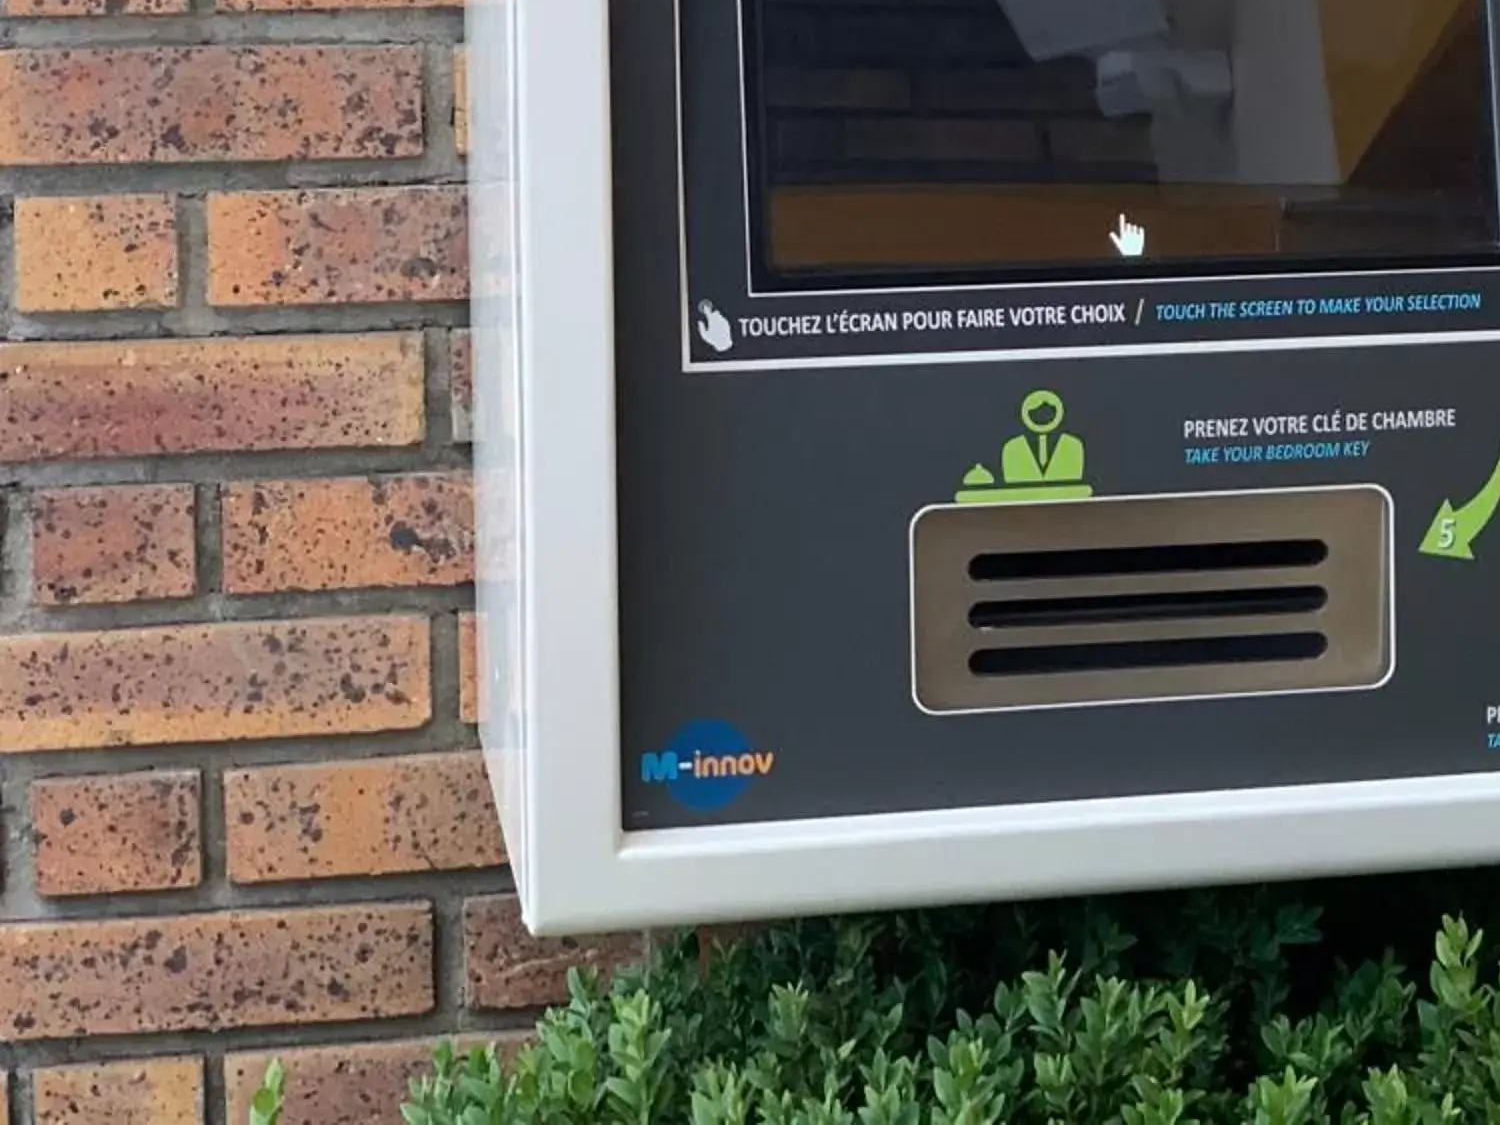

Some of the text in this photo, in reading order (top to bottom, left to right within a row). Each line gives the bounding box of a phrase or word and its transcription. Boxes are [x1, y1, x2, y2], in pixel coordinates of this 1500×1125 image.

[738, 315, 821, 337] TOUCHEZ
[902, 310, 953, 331] POUR
[957, 308, 1005, 329] FAIRE
[1010, 306, 1067, 327] VOTRE
[1071, 303, 1126, 324] CHOIX
[1155, 303, 1205, 322] TOUCH
[1209, 302, 1236, 319] THE
[1239, 299, 1292, 318] SCREEN
[1297, 299, 1317, 316] TO
[1319, 297, 1361, 316] MAKE
[1365, 296, 1404, 314] YOUR
[1407, 293, 1482, 312] SELECTION
[1183, 408, 1456, 439] PRENEZ VOTRE CLÉ DE CHAMBRE
[1184, 439, 1371, 465] TAKE YOUR BEDROOM KEY
[1437, 518, 1455, 549] 5
[641, 749, 774, 783] M-innov
